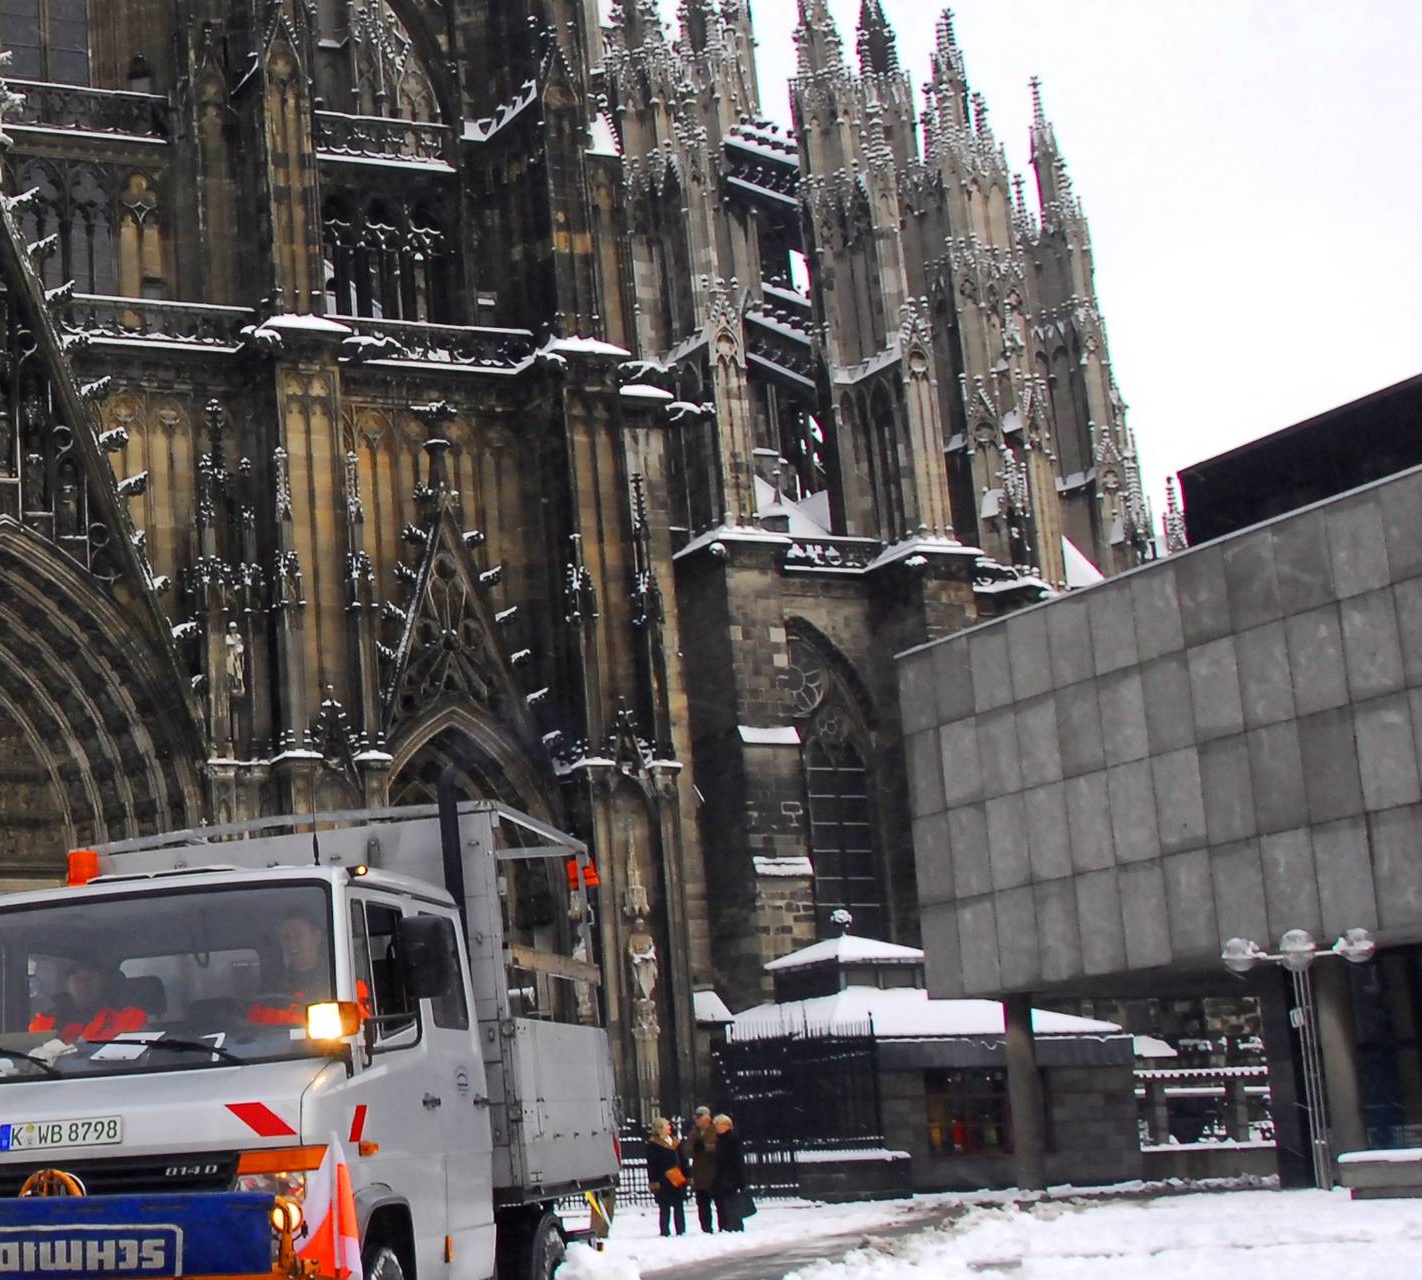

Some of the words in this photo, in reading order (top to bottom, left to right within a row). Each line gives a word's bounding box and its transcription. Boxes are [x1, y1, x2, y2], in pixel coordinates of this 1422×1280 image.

[11, 1127, 23, 1146] K
[38, 1124, 62, 1144] WB
[68, 1120, 118, 1141] 8798
